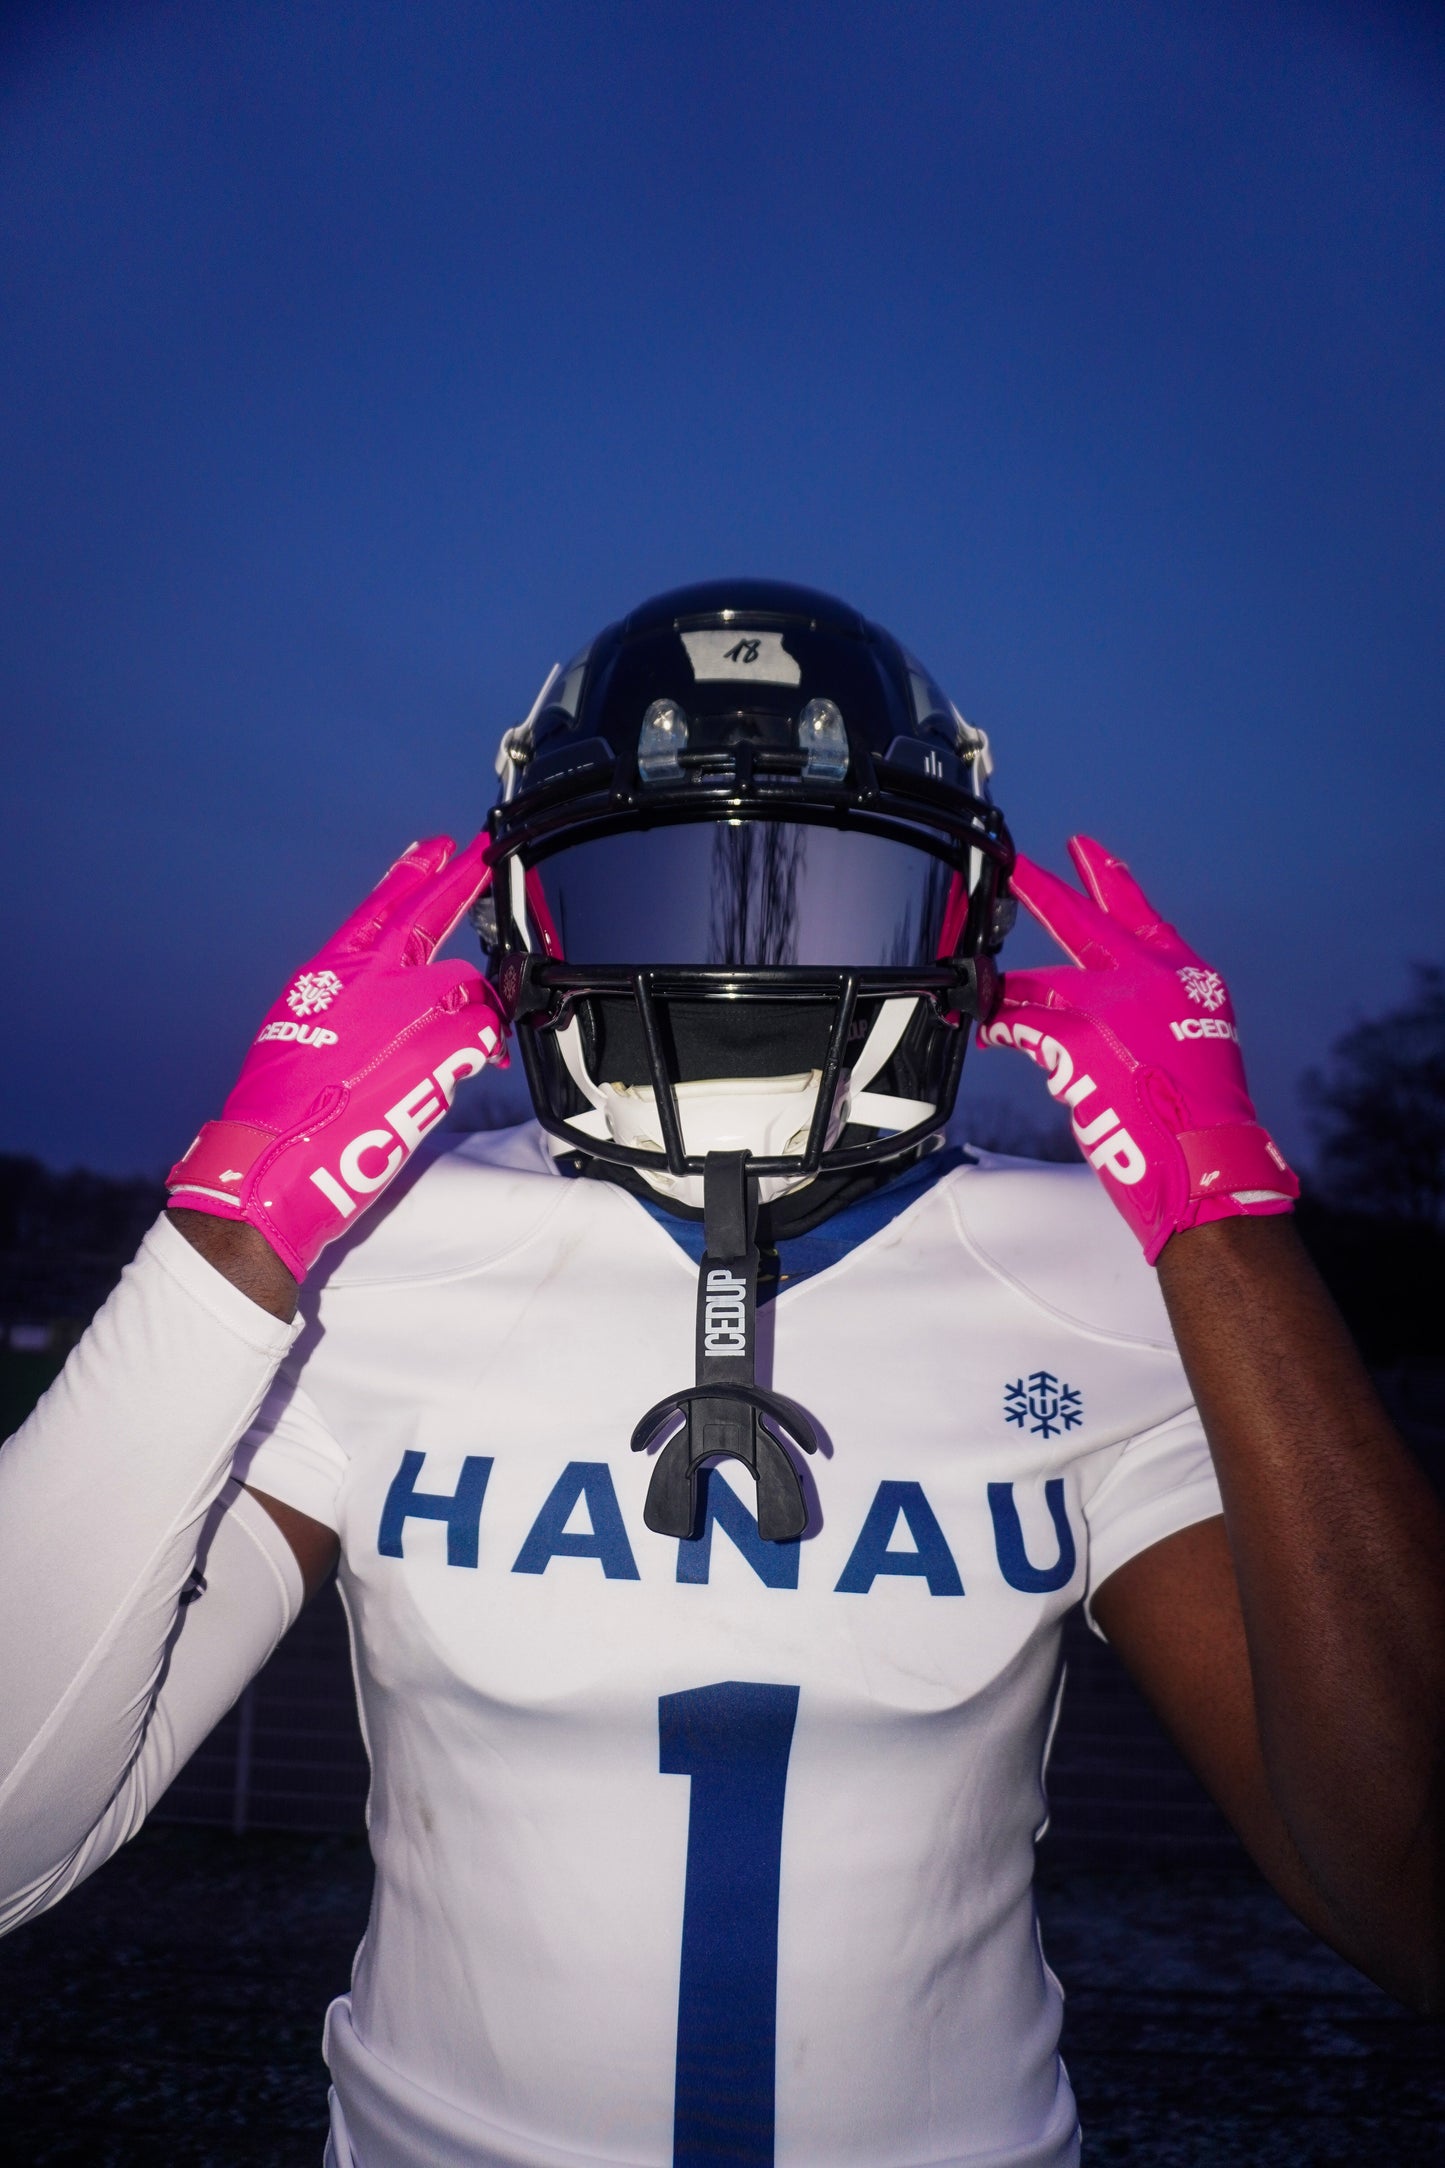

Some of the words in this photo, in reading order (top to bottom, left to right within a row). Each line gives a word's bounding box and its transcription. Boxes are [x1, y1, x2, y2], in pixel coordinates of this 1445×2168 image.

[724, 638, 761, 664] 18
[255, 1021, 339, 1048] CEDUP
[704, 1269, 747, 1357] ICEDUP
[376, 1450, 1077, 1597] HANAU
[658, 1680, 801, 2168] 1
